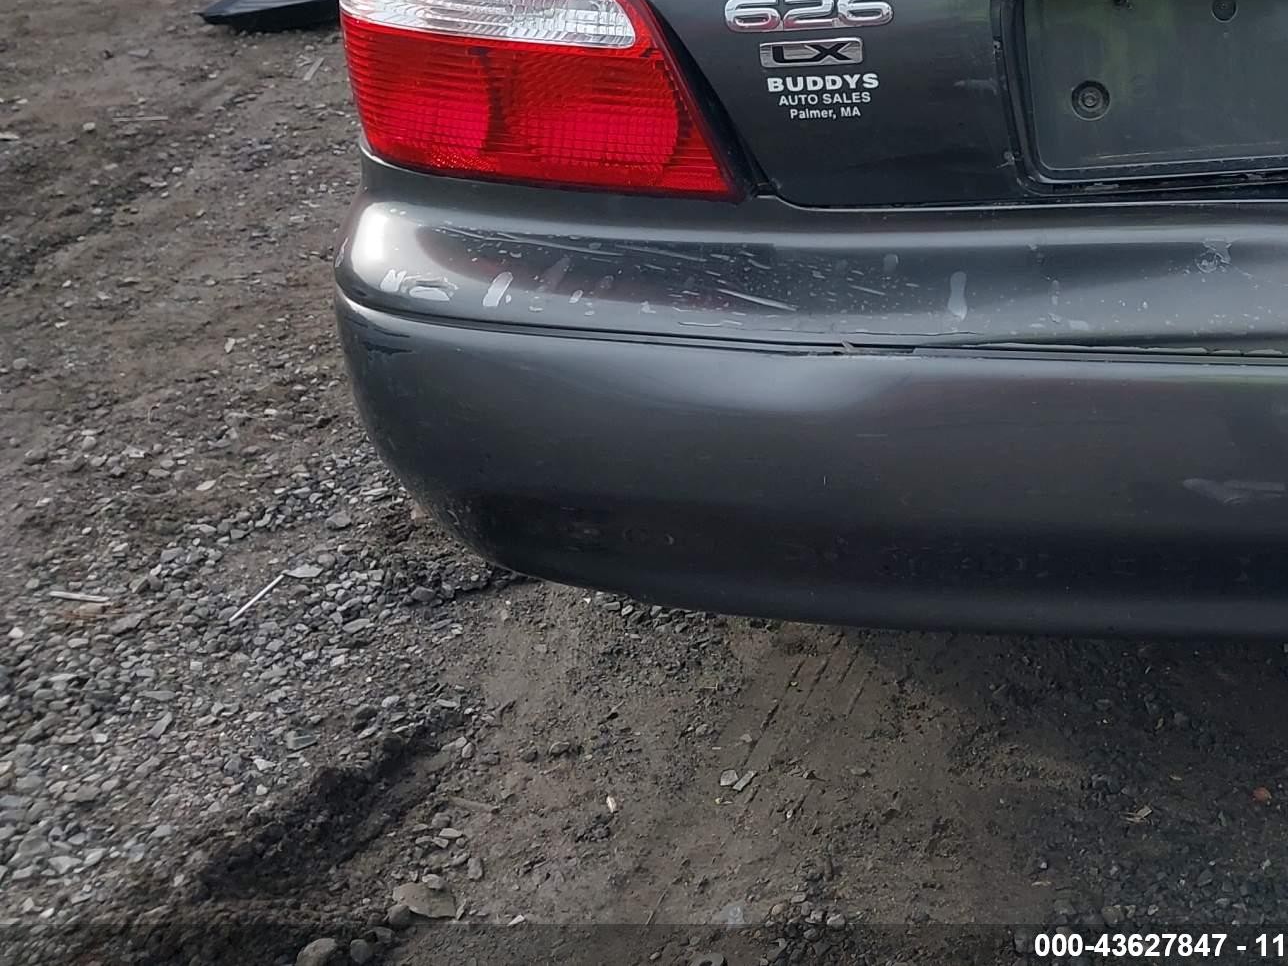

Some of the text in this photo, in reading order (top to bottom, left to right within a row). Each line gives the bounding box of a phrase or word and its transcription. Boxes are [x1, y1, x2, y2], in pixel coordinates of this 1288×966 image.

[772, 42, 851, 64] LX
[766, 73, 879, 92] BUDDYS
[778, 91, 871, 107] AUTO SALES
[790, 107, 861, 120] Palmer, MA
